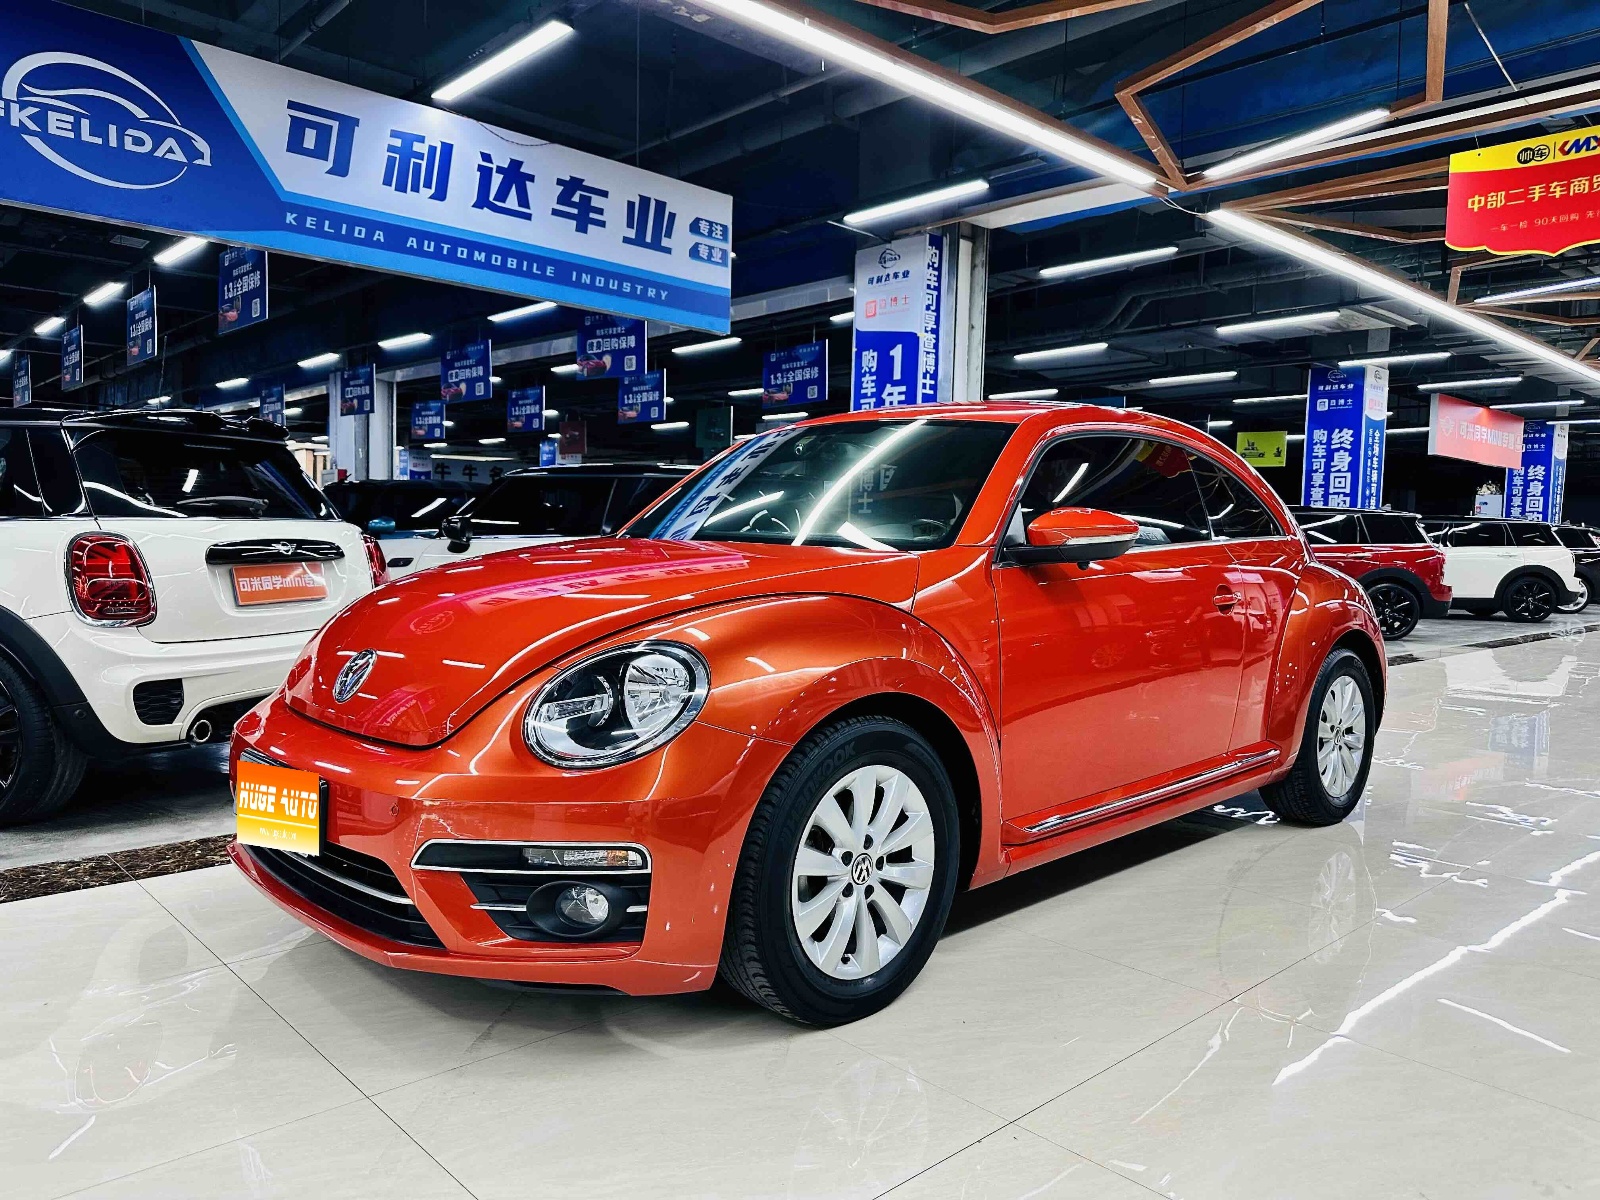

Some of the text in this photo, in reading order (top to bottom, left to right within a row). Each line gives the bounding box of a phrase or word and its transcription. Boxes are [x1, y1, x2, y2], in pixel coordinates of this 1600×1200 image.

[10, 103, 188, 163] KELIDA
[285, 99, 677, 255] 可利达车业
[286, 211, 669, 301] KELIDA AUTOMOBILE INDUSTRY
[697, 219, 724, 240] 专注
[697, 244, 723, 263] 专业
[867, 270, 910, 286] 可利达车业
[1328, 428, 1354, 508] 终身回购
[1526, 465, 1546, 521] 终身回购
[238, 575, 325, 592] 可米同学mini专
